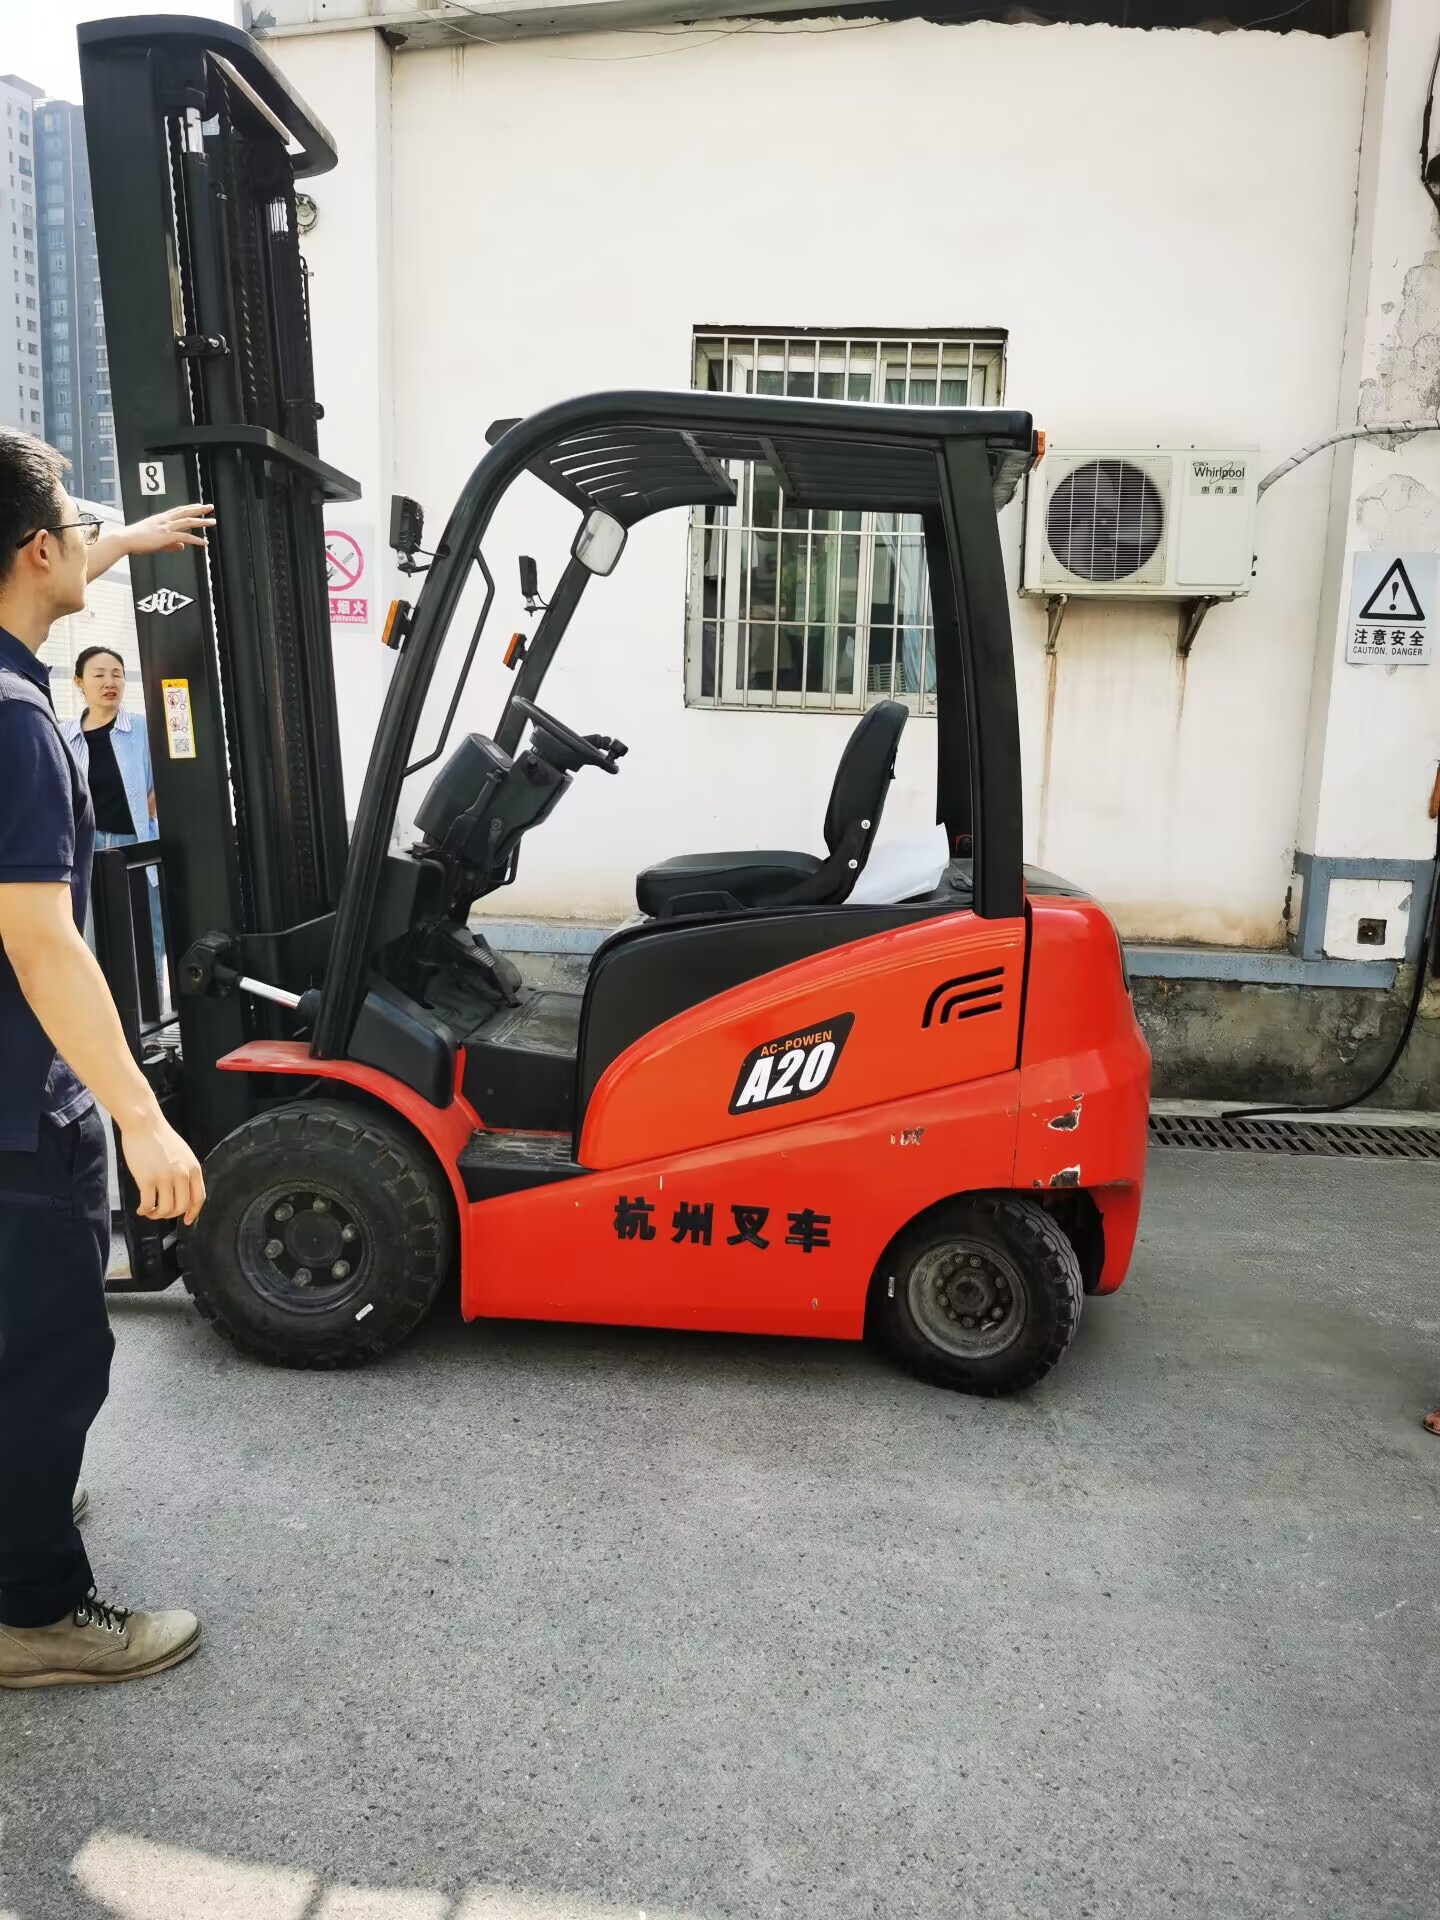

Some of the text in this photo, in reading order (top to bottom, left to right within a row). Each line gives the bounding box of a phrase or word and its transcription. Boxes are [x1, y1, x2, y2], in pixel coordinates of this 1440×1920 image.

[1193, 466, 1245, 480] Whirlpool
[1354, 628, 1424, 646] 注意安全
[1391, 647, 1423, 656] DANGER
[760, 1030, 832, 1057] AC-POWEN
[735, 1041, 836, 1107] A20
[613, 1195, 831, 1253] 杭州叉车
